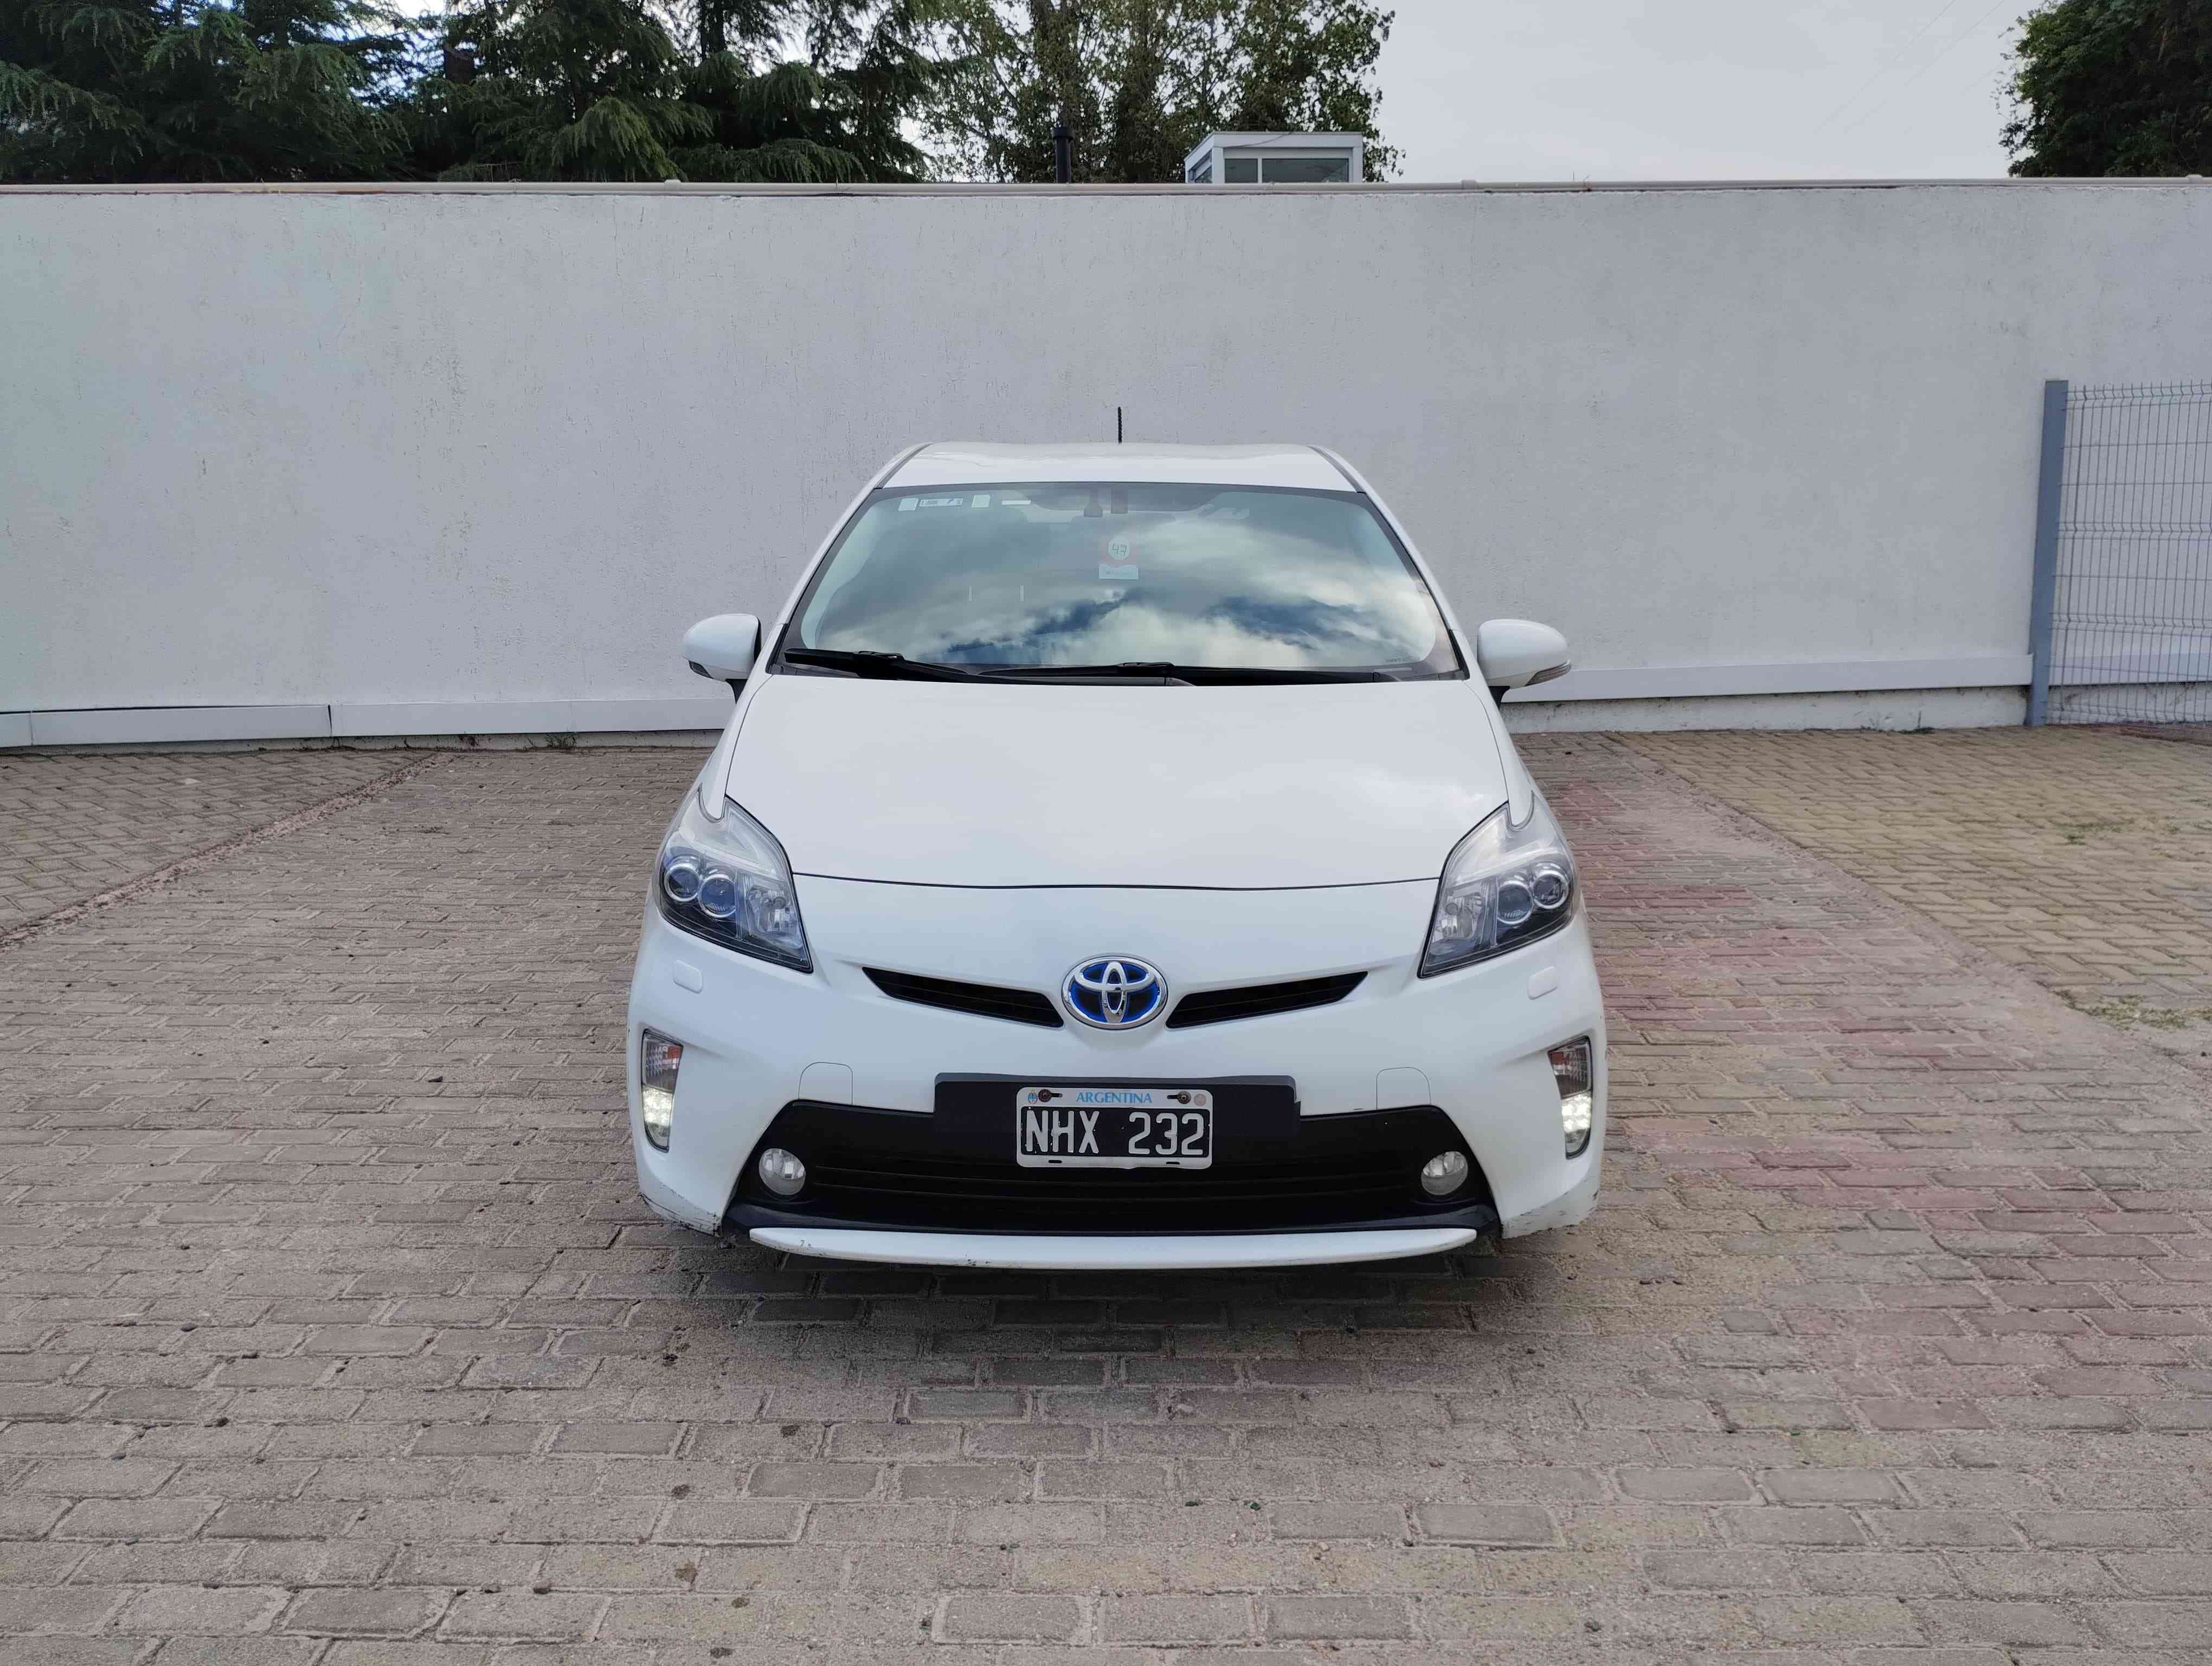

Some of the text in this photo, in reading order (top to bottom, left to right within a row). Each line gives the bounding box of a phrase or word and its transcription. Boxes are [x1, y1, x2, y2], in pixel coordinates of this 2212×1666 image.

[1076, 1092, 1153, 1104] ARGENTINA
[1026, 1110, 1204, 1155] NHX 232
